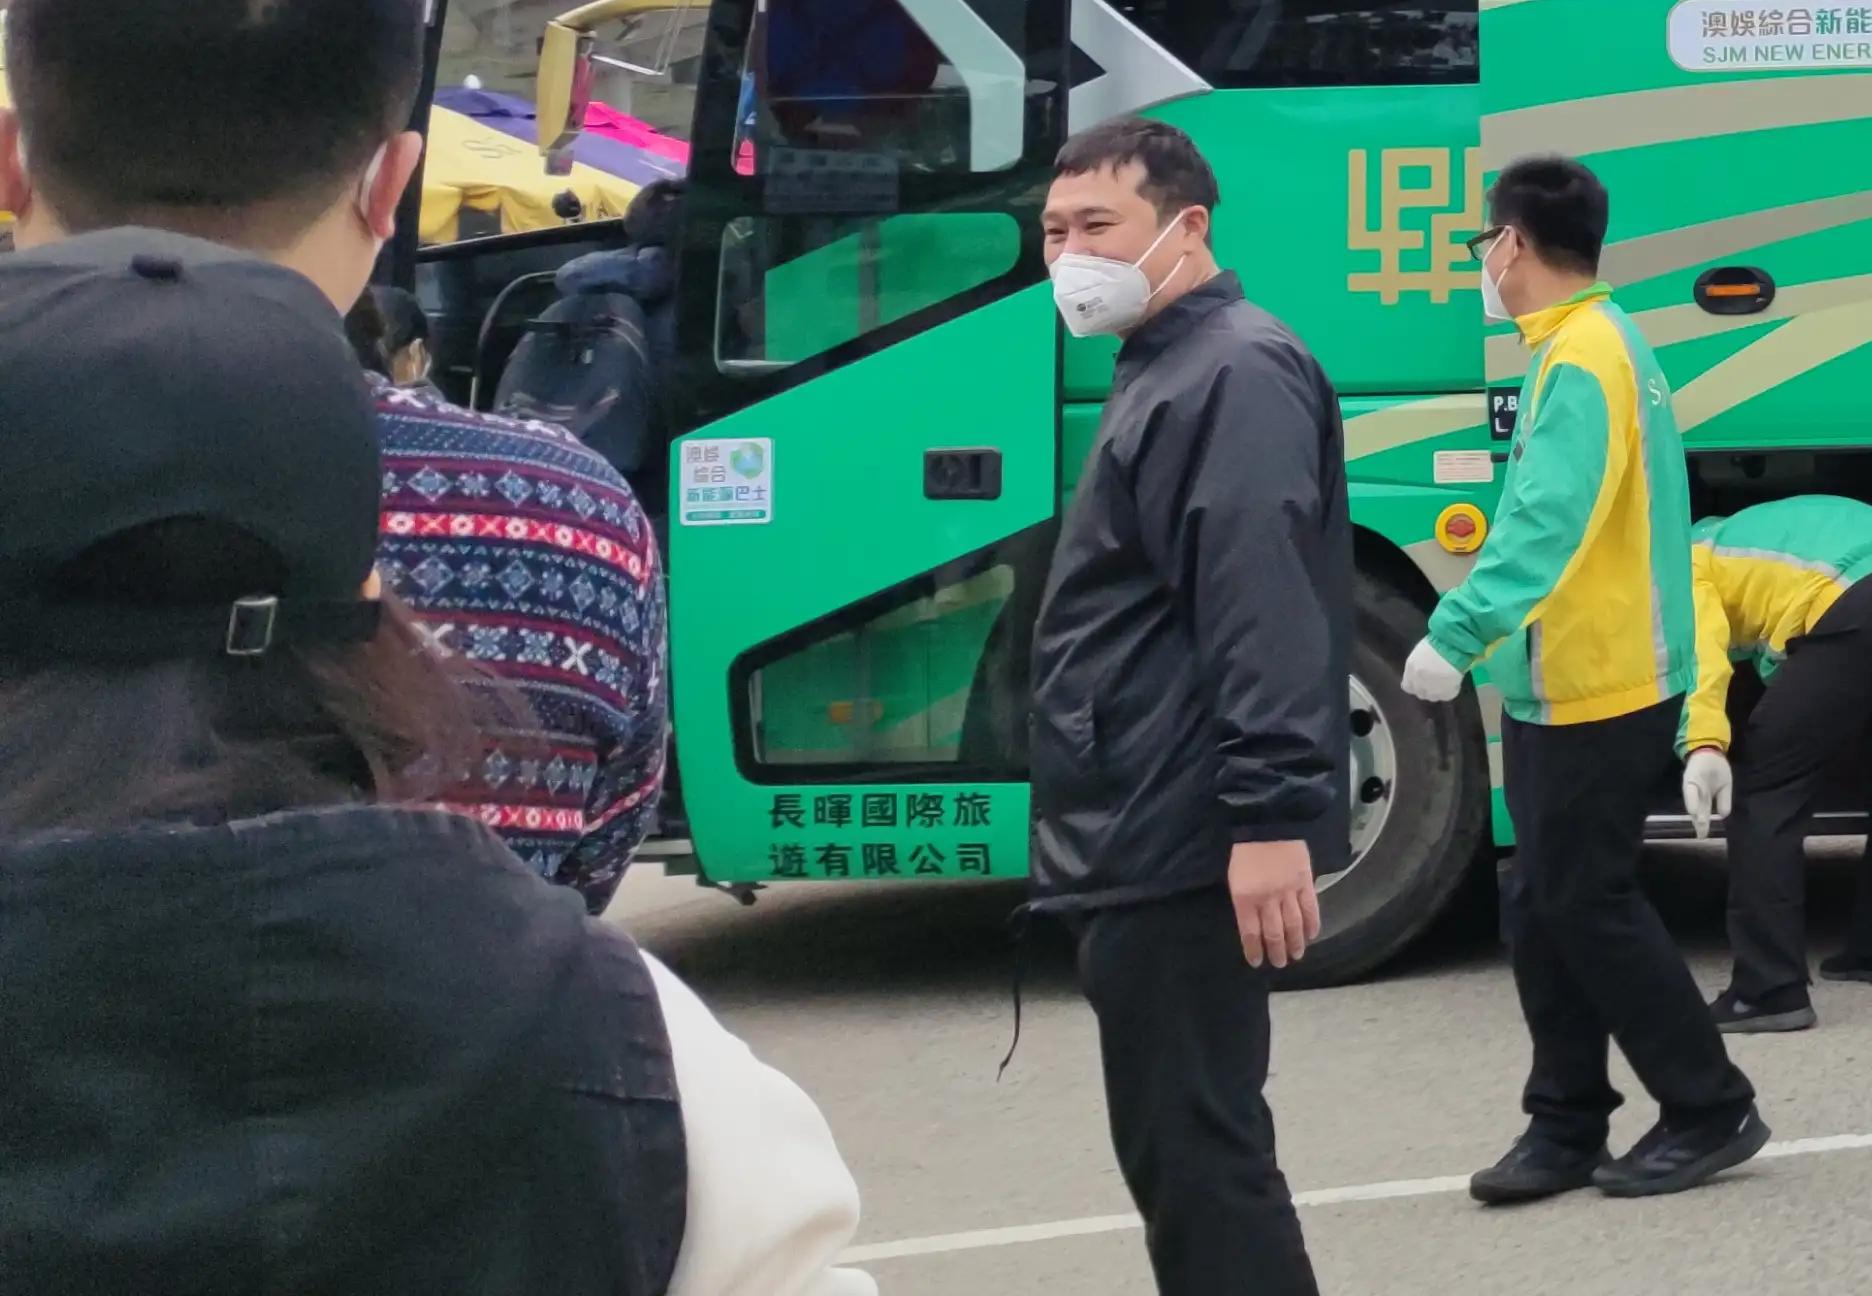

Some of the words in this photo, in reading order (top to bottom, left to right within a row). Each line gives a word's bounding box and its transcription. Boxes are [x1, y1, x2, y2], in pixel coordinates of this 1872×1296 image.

[1702, 46, 1747, 64] SJM
[1754, 44, 1802, 62] NEW
[768, 791, 992, 830] 長暉國際旅
